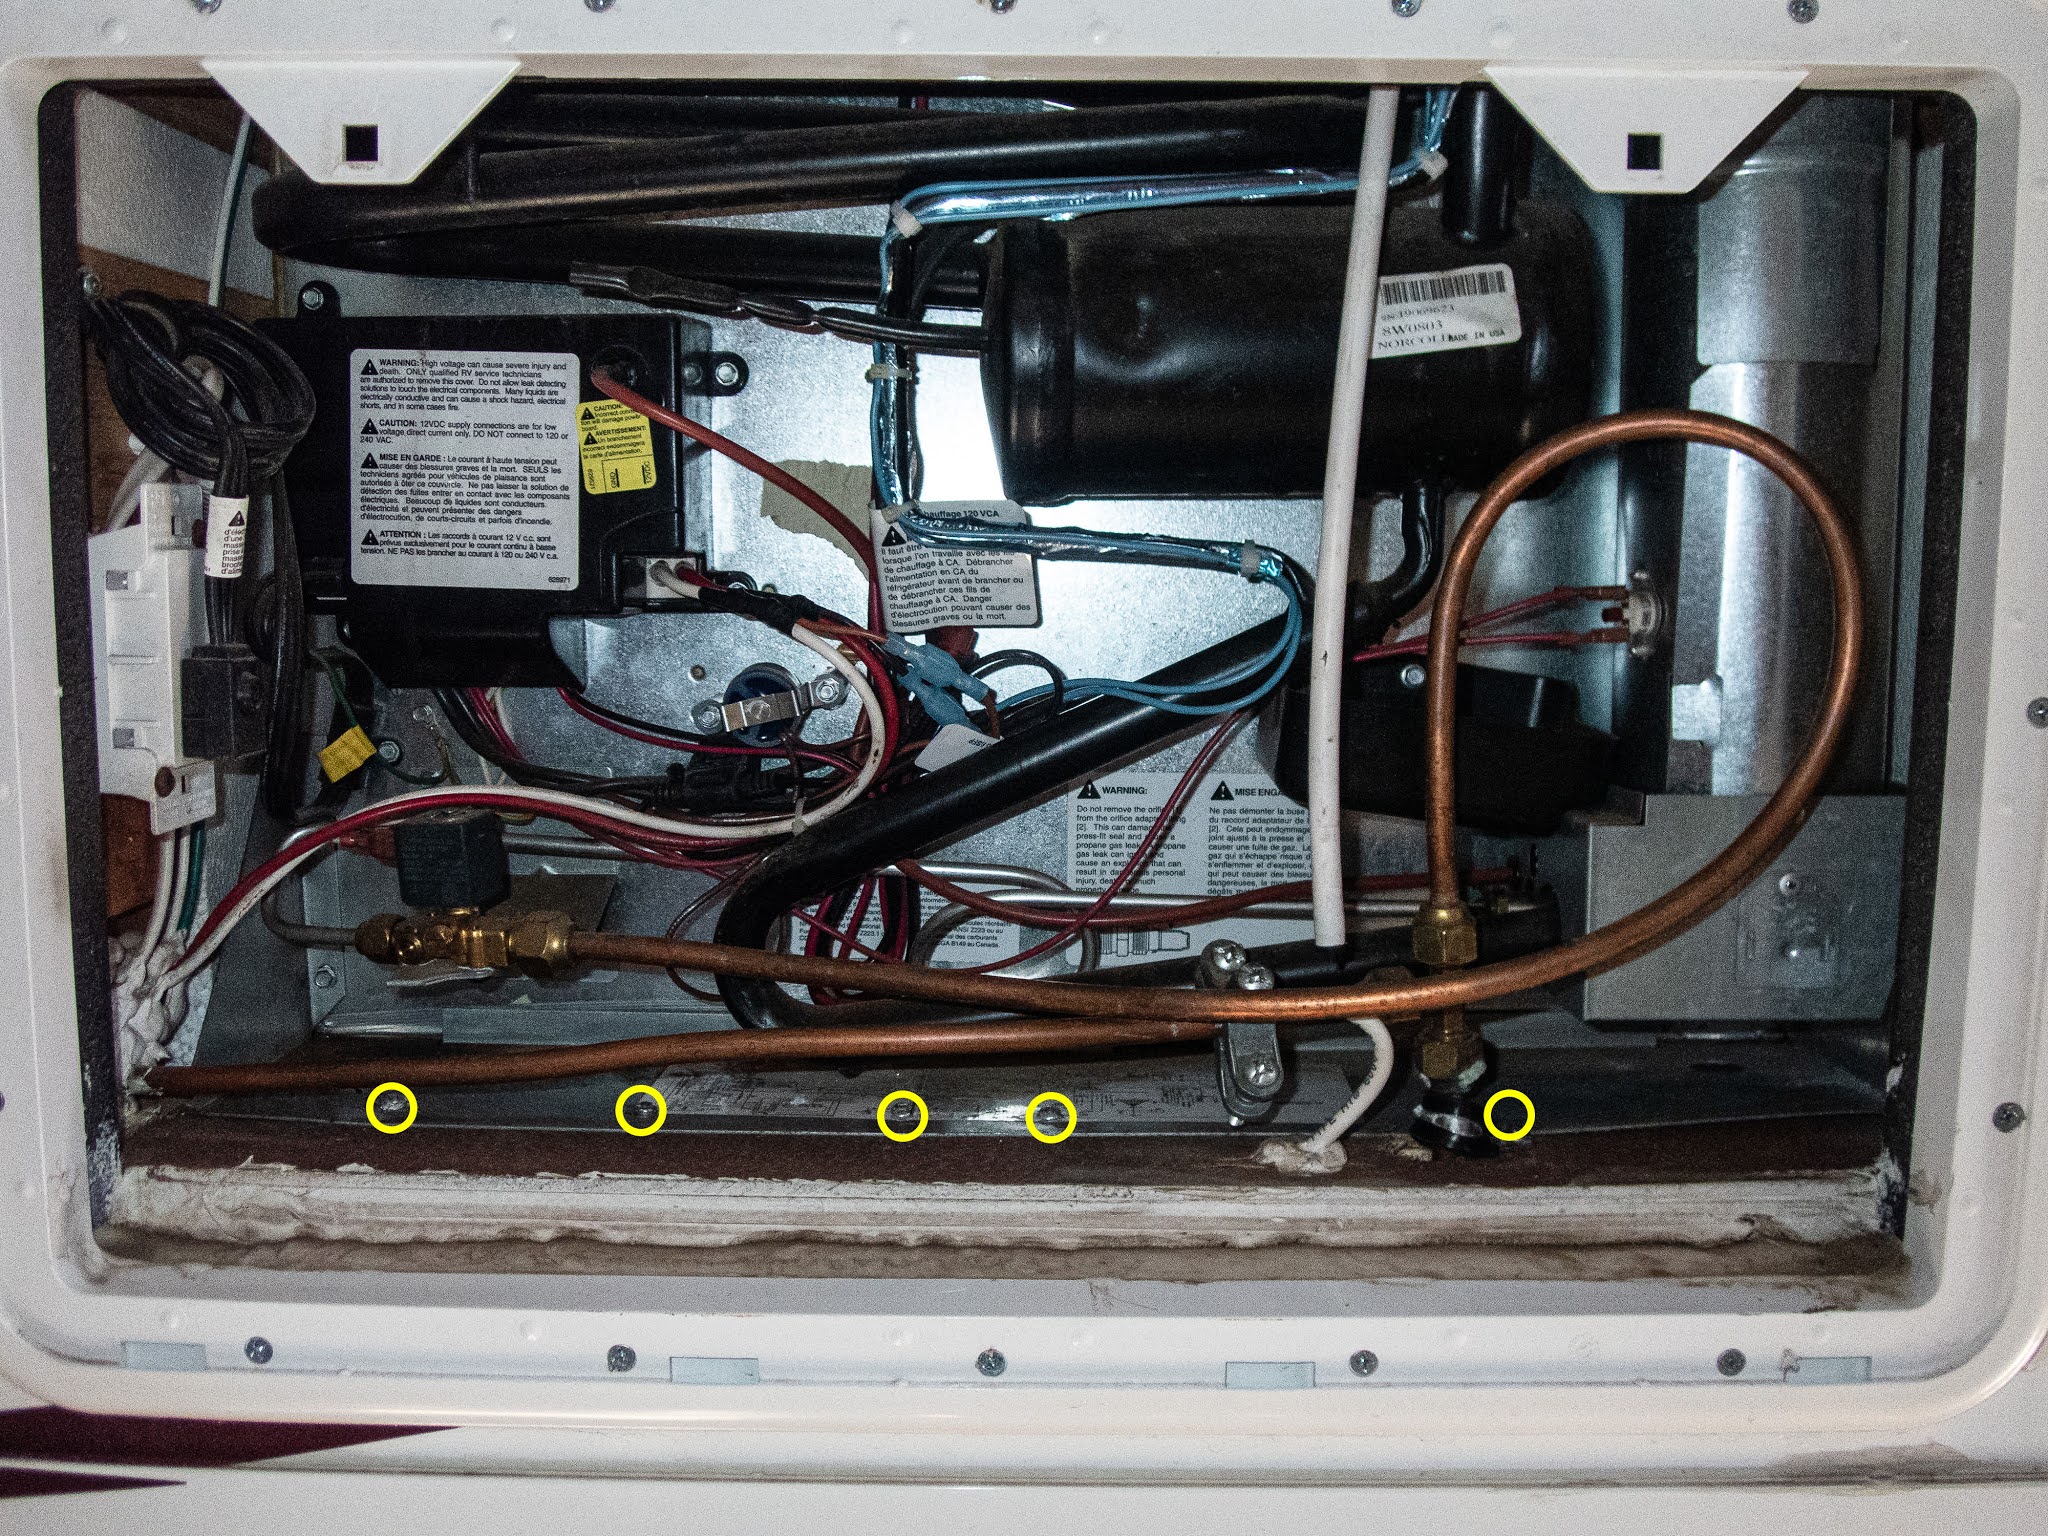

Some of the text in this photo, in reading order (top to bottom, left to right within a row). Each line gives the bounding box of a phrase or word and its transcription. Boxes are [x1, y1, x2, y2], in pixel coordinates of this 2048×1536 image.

[1449, 333, 1467, 342] MADE
[440, 361, 465, 369] voltage
[429, 370, 458, 378] qualified
[380, 429, 404, 437] voltage
[596, 426, 646, 436] AVERTISSEMENT:
[888, 546, 904, 555] faut
[883, 556, 911, 565] lorsque
[896, 560, 936, 573] chauffage
[885, 569, 937, 583] l'alimentation
[887, 579, 935, 592] réfrigérateur
[901, 587, 946, 600] débrancher
[963, 595, 992, 603] Danger
[891, 606, 948, 619] d'électrocution
[892, 617, 930, 627] blessures
[933, 614, 960, 623] graves
